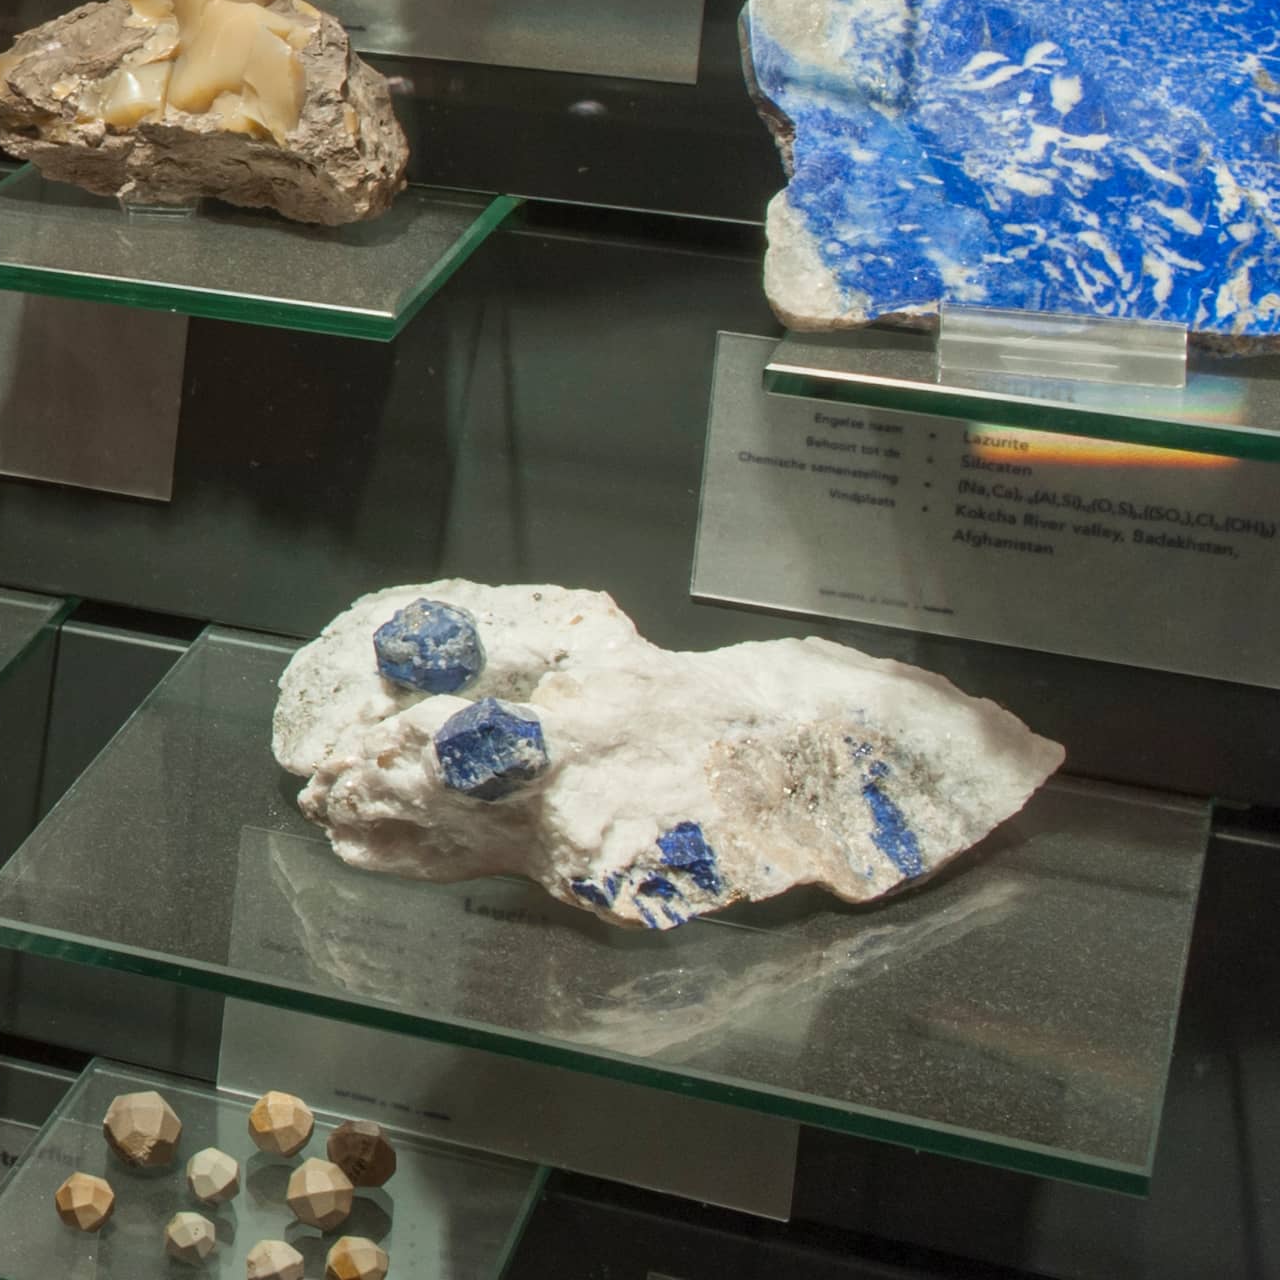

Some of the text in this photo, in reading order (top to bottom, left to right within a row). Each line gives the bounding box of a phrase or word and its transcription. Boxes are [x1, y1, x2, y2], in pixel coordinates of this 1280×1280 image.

[963, 431, 1030, 454] Lazurite
[960, 455, 1033, 477] Silicaten
[954, 503, 1017, 525] Kokcha
[1024, 512, 1067, 532] River
[1072, 523, 1125, 544] valley,
[952, 528, 1054, 554] Afghanistan
